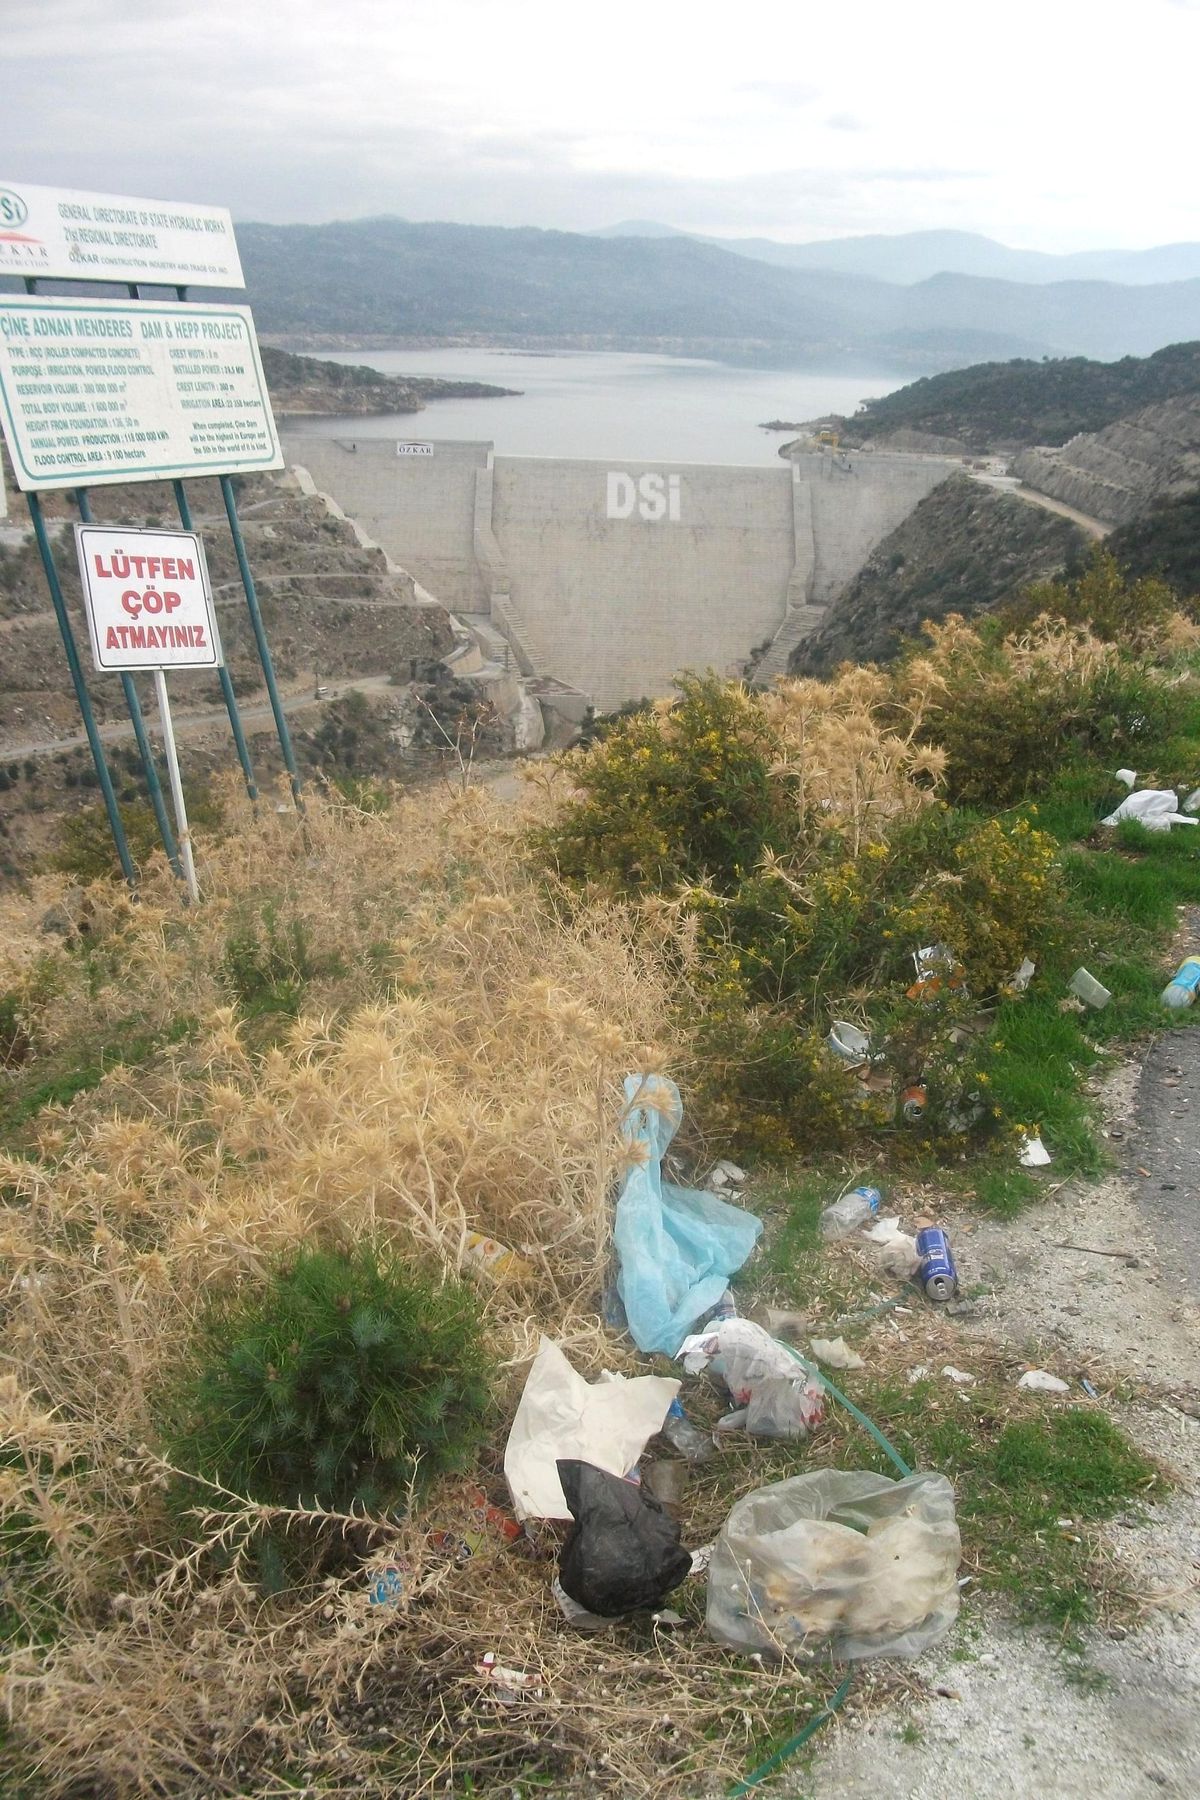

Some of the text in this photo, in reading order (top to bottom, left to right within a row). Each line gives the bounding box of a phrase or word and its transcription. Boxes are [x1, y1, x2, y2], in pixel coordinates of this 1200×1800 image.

[58, 203, 226, 234] GENERAL DIRECTORATE OF STATE HYDRAULIC WORKS
[78, 228, 114, 246] REGIONAL
[113, 231, 159, 249] DIRECTORATE
[33, 316, 73, 337] ADNAN
[74, 318, 133, 338] MENDERES
[140, 321, 164, 338] DAM
[165, 321, 174, 338] &
[174, 321, 201, 339] HEPP
[202, 322, 244, 340] PROJECT
[70, 347, 108, 359] COMPACTED
[169, 349, 187, 359] CREST
[187, 349, 205, 359] WIDTH
[127, 364, 154, 376] CONTROL
[173, 364, 202, 375] INSTALLED
[16, 382, 53, 396] RESERVOIR
[176, 382, 195, 392] CREST
[21, 403, 43, 415] TOTAL
[42, 402, 61, 414] BODY
[26, 420, 50, 432] HEIGHT
[50, 419, 70, 431] FROM
[245, 420, 258, 429] Dam
[30, 437, 57, 449] ANNUAL
[56, 435, 80, 448] POWER
[189, 434, 199, 443] will
[198, 434, 206, 442] be
[206, 434, 215, 442] the
[214, 432, 235, 443] highest
[239, 431, 257, 441] Europe
[256, 431, 266, 439] and
[193, 446, 203, 455] the
[211, 444, 218, 453] in
[217, 444, 226, 453] the
[226, 443, 241, 452] world
[34, 454, 57, 466] FLOOD
[56, 452, 87, 465] CONTROL
[112, 448, 124, 460] 100
[122, 447, 147, 459] hectare
[94, 548, 196, 580] LÜTFEN
[121, 584, 182, 620] ÇÖP
[106, 626, 207, 649] ATMAYINIZ
